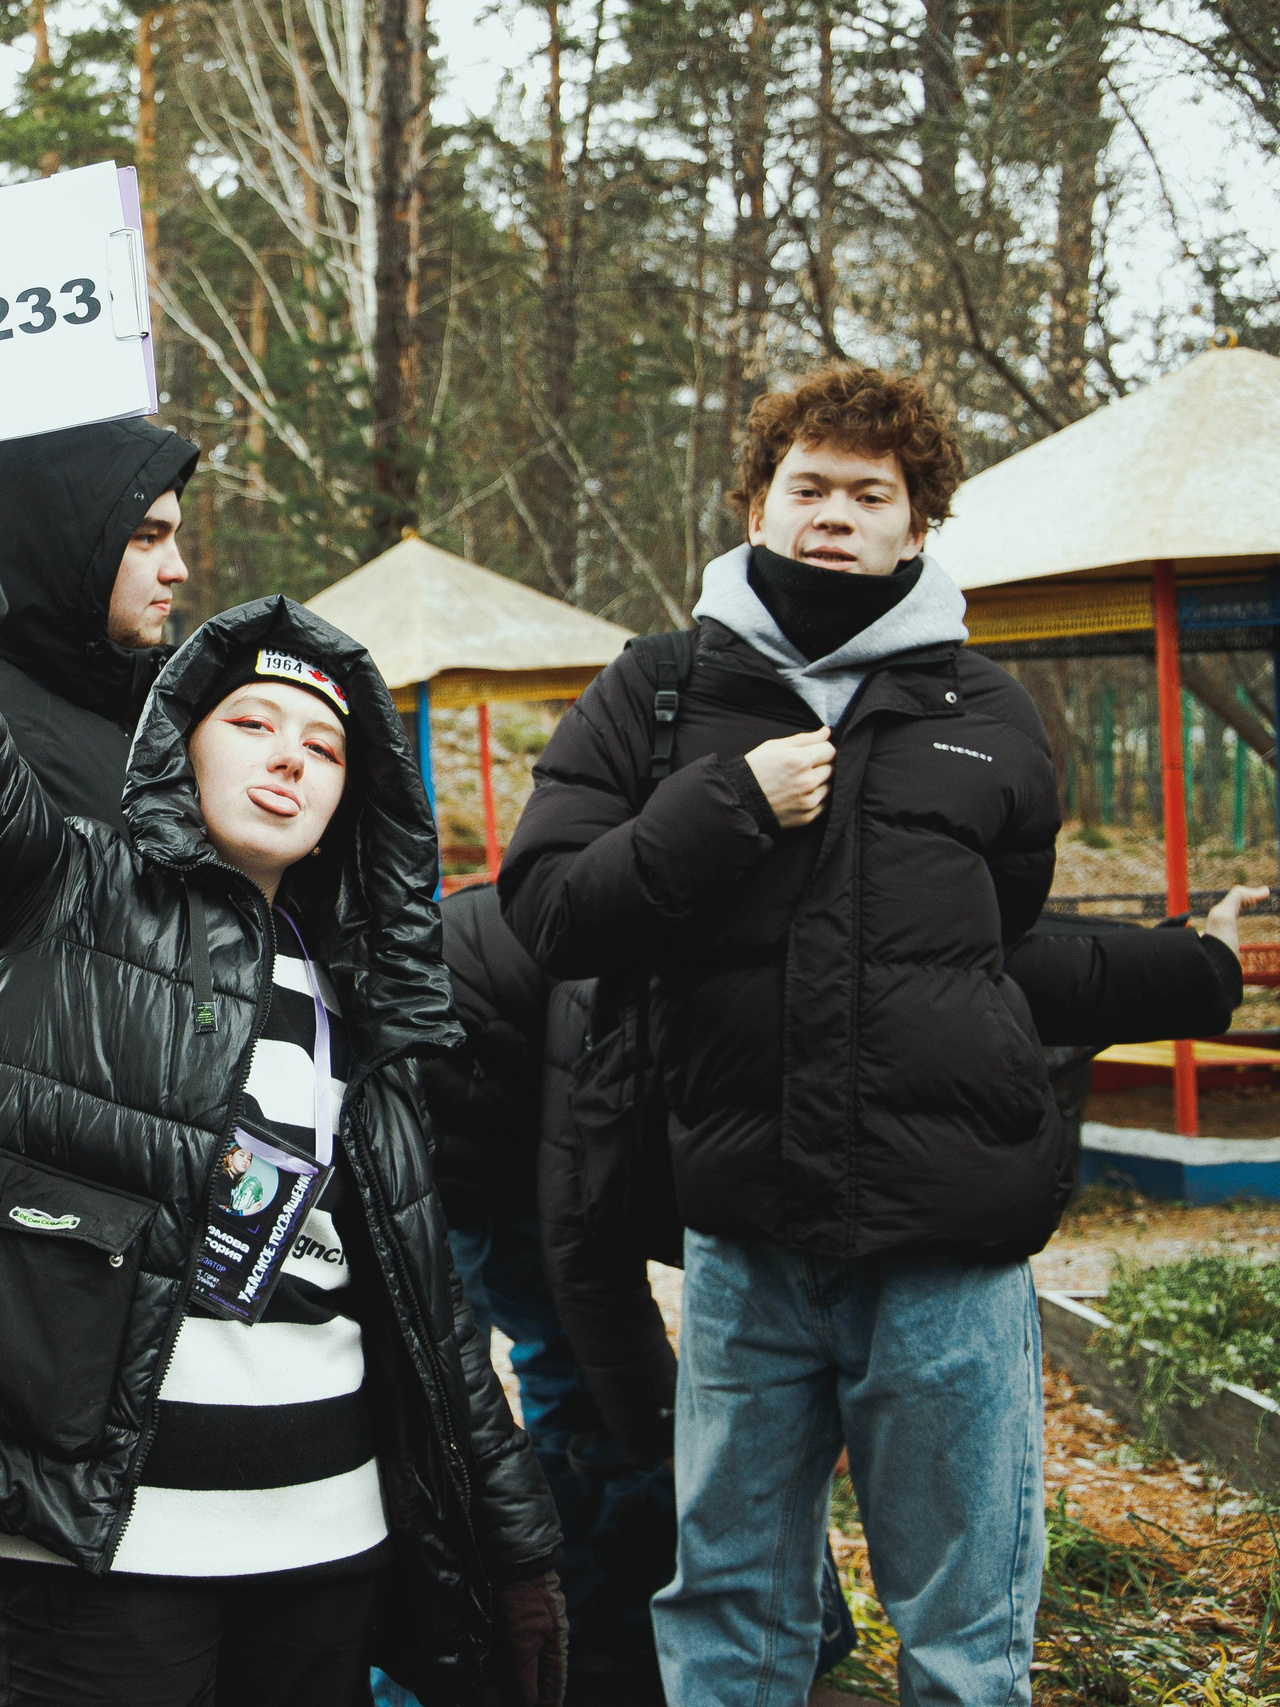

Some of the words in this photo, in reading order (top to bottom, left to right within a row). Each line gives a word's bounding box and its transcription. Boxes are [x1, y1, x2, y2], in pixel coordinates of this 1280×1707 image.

[265, 657, 303, 674] 1964
[237, 1245, 275, 1304] УЖАСНОЕ
[269, 1173, 315, 1247] ПОСВЯЩЕНИ
